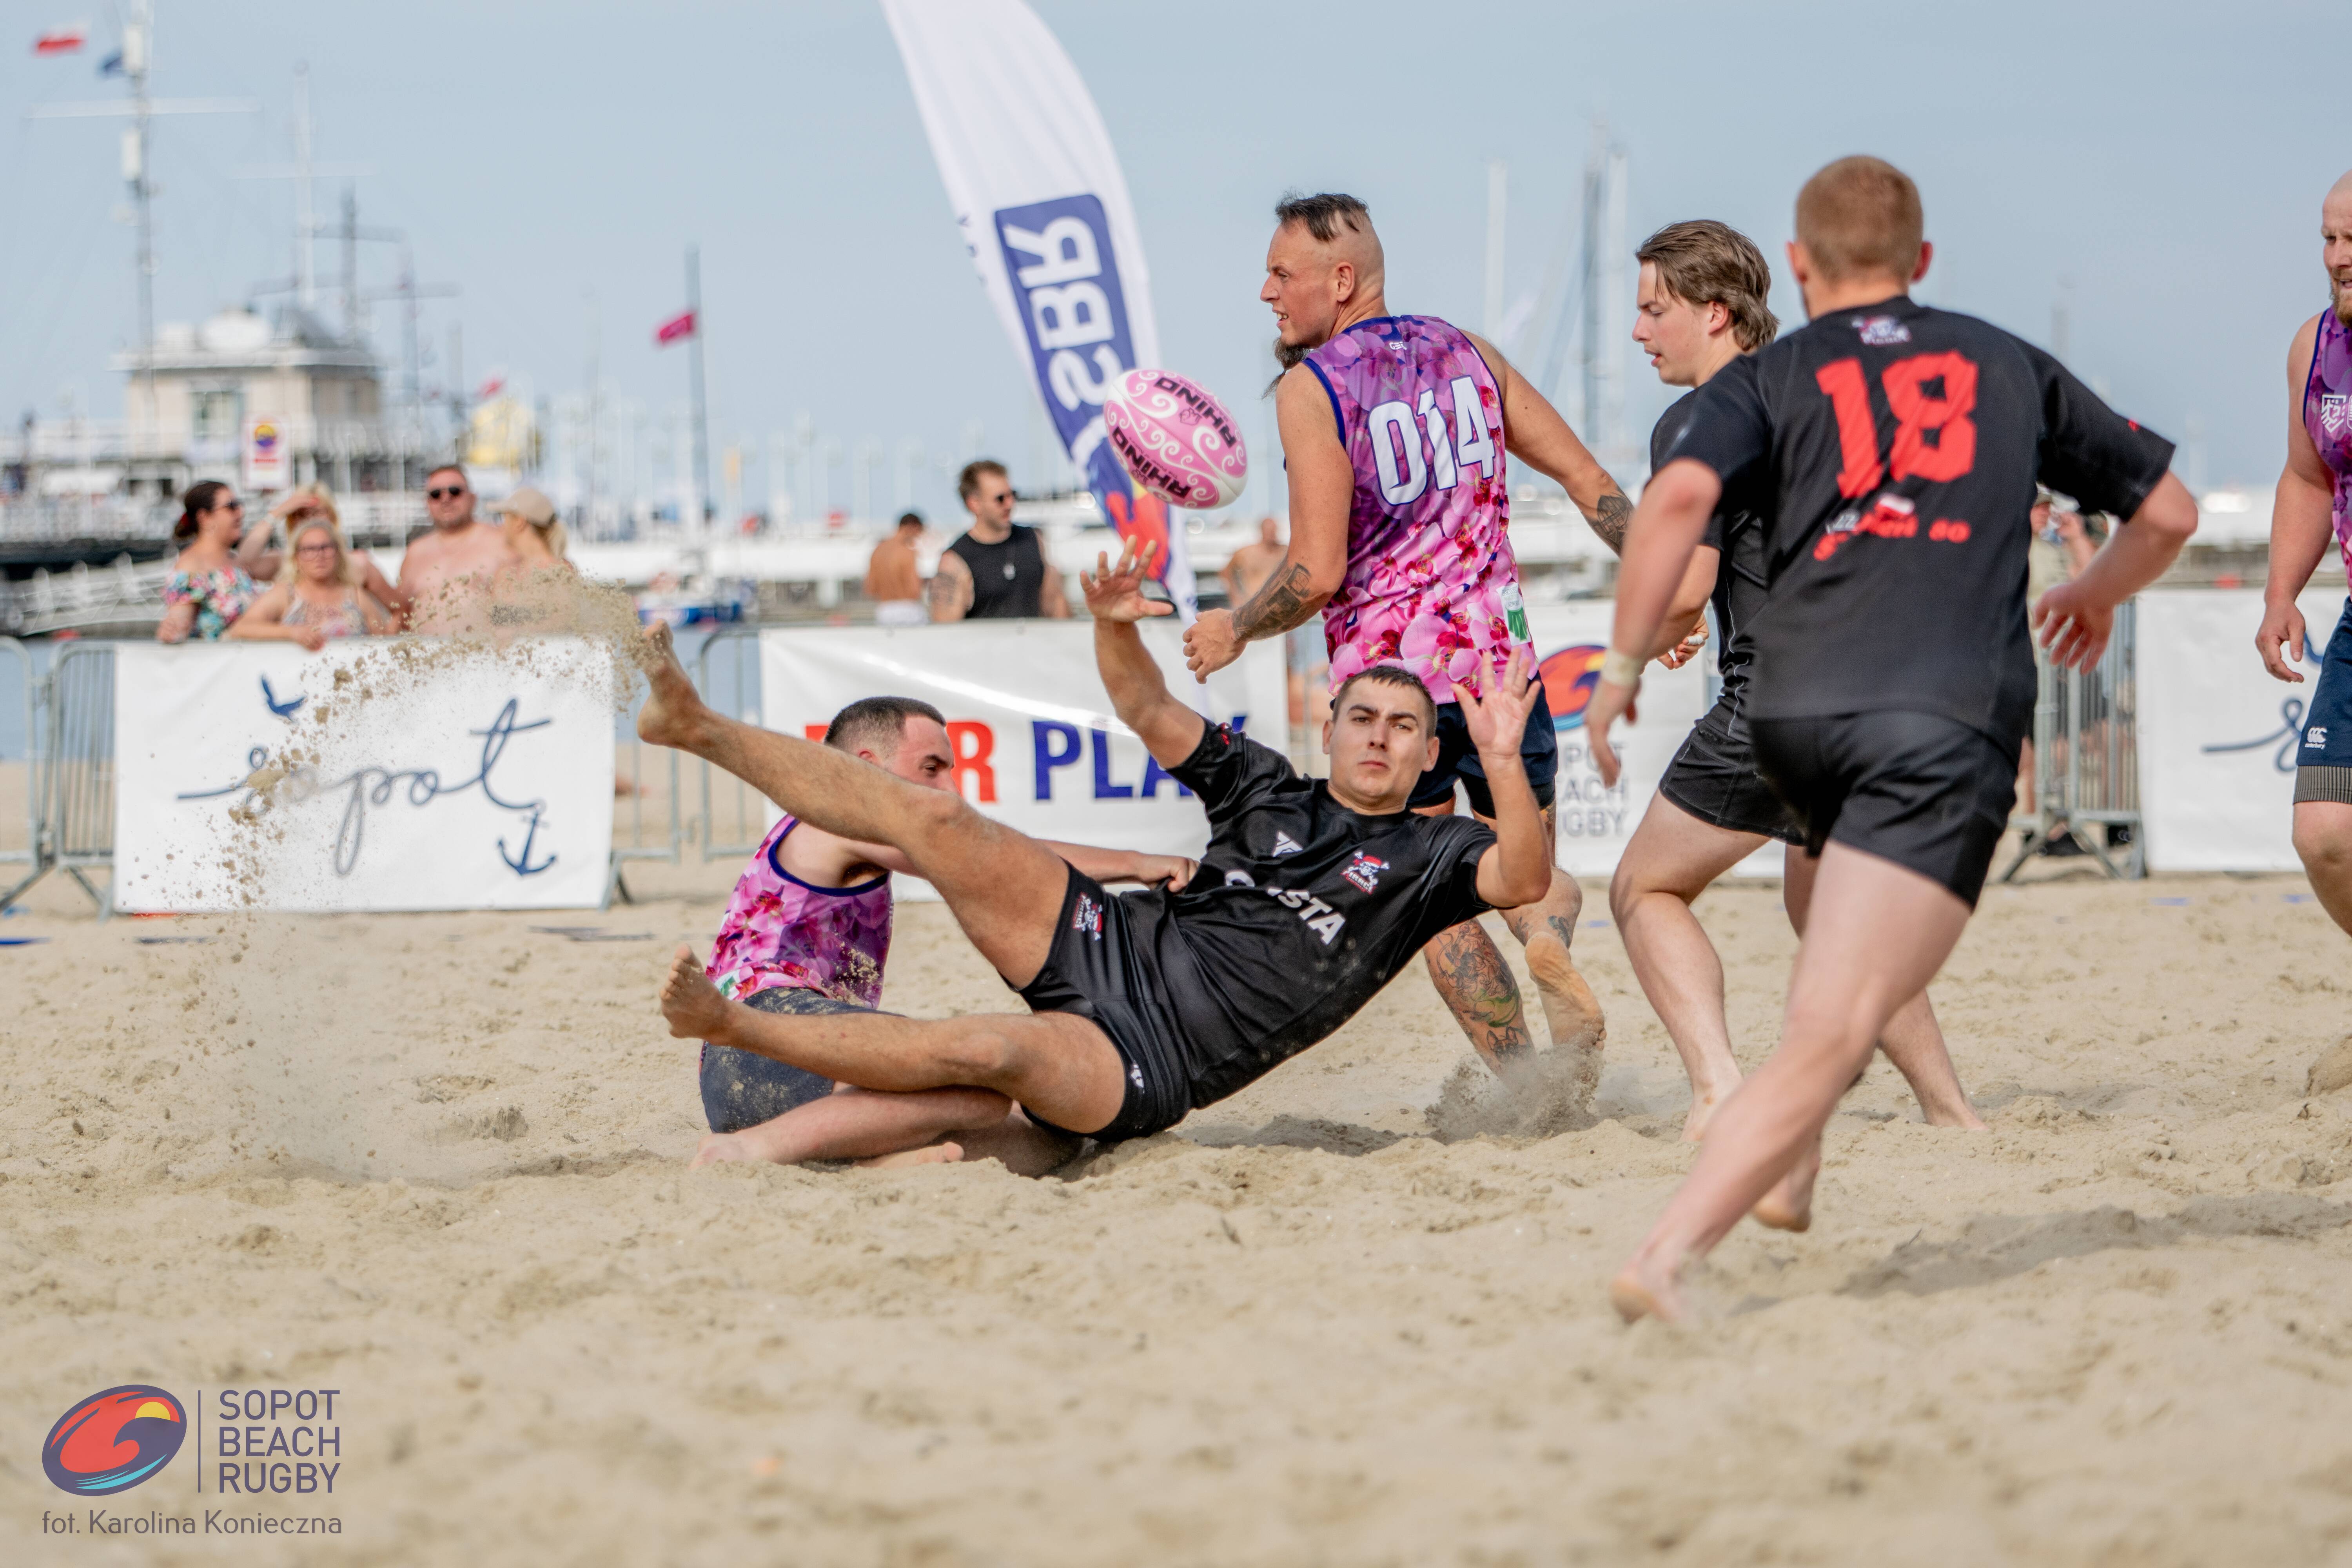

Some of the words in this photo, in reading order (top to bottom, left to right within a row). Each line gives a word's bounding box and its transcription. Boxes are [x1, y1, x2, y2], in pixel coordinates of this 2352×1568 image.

[1112, 426, 1192, 499] RHINO
[1154, 377, 1237, 449] RHINO
[1368, 375, 1495, 506] 014
[1815, 349, 1978, 499] 18
